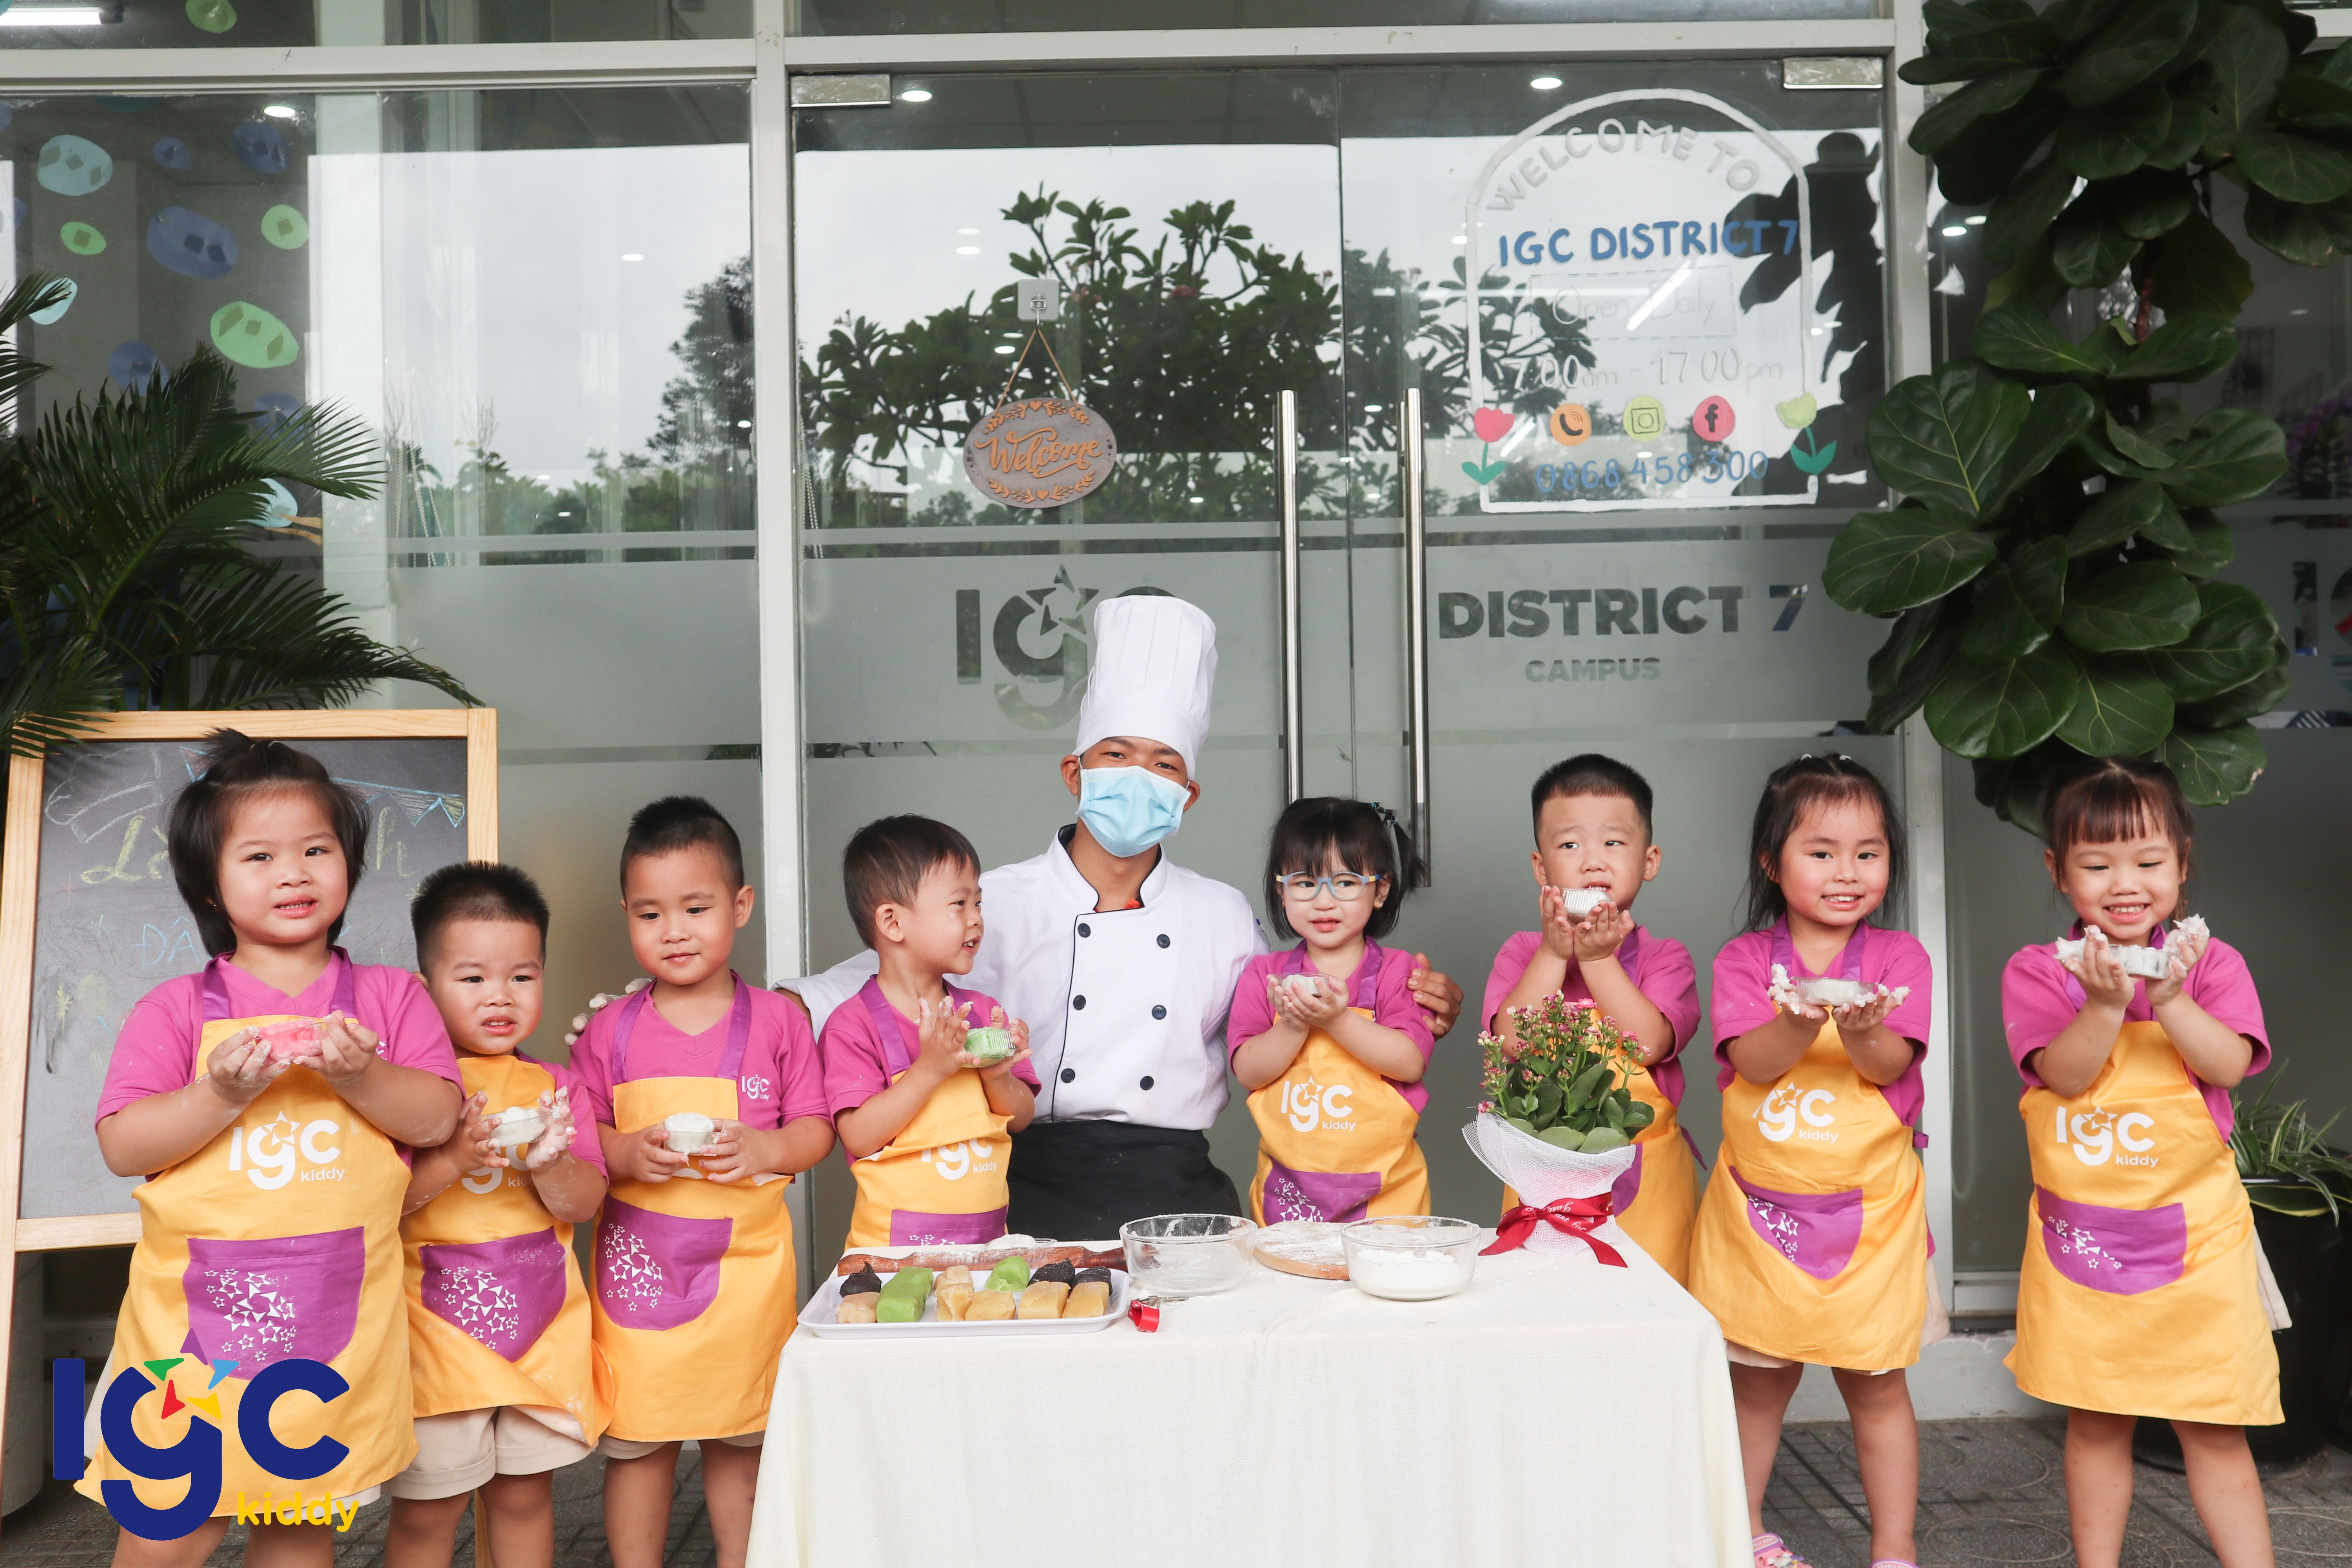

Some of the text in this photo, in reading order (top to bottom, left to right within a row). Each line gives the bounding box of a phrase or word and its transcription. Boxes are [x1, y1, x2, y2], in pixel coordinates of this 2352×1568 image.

[1487, 118, 1760, 211] WELCOME TO
[1500, 220, 1799, 267] IGC DISTRICT 7
[1552, 278, 1716, 333] Open Daily
[975, 427, 1103, 478] Welcome
[1536, 450, 1769, 493] 0868 458 300
[1438, 584, 1808, 639] DISTRICT 7
[1525, 657, 1661, 683] CAMPUS
[1322, 1120, 1356, 1131] kiddy
[1799, 1129, 1838, 1143] kiddy
[300, 1167, 345, 1182] kiddy
[973, 1161, 997, 1173] kiddy
[2115, 1154, 2159, 1168] kiddy
